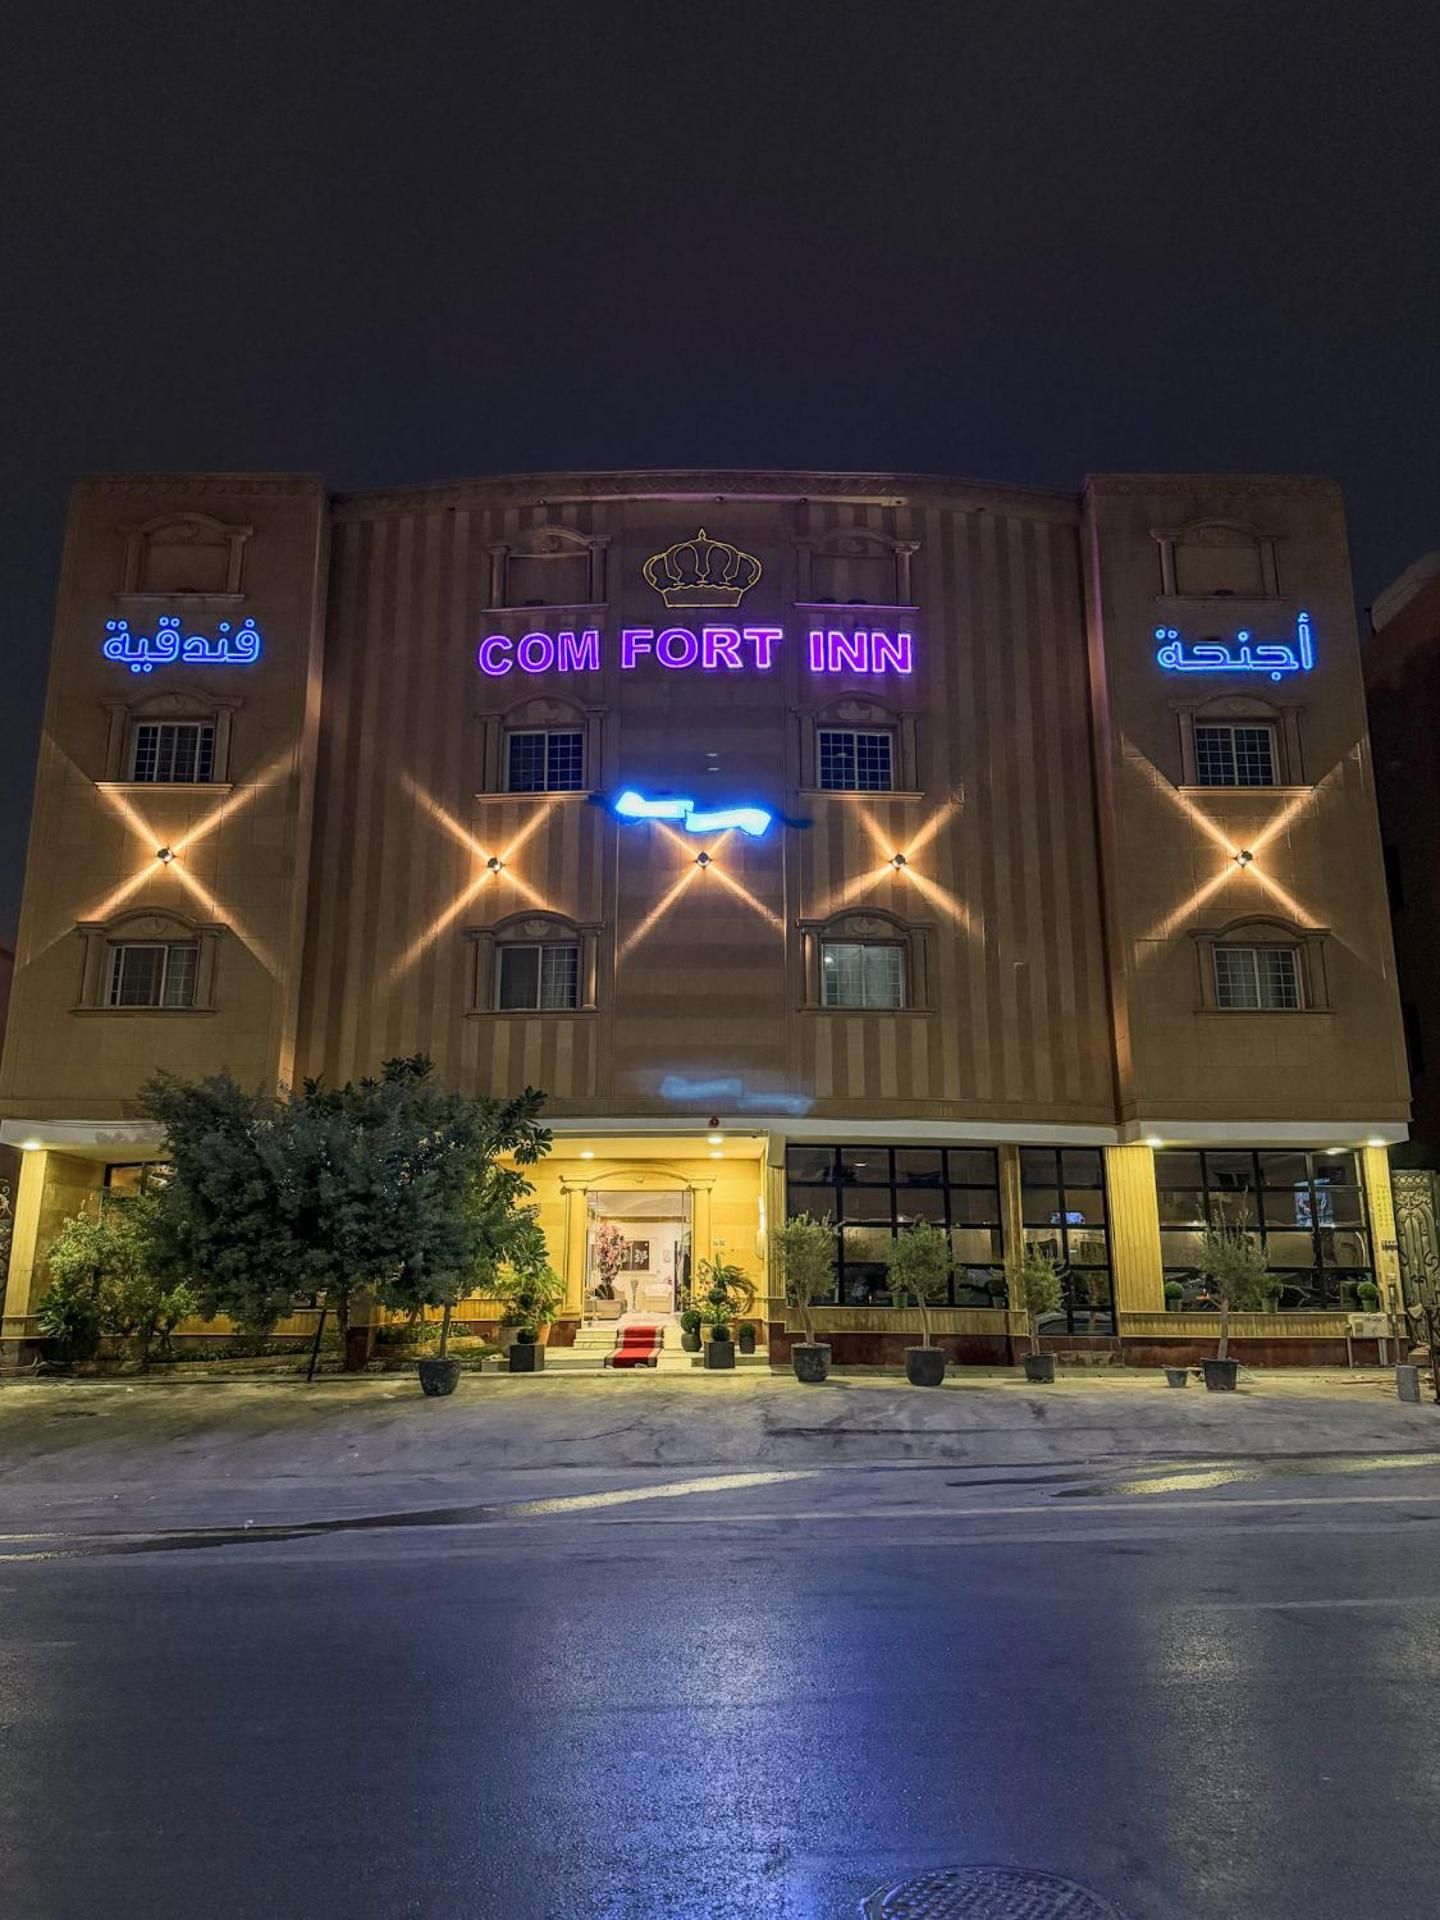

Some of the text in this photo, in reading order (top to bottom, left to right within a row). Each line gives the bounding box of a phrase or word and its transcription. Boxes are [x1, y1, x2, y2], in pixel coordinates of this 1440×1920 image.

[103, 616, 261, 673] فندقية
[478, 627, 914, 676] COM FORT INN
[1155, 611, 1313, 681] أجنحة
